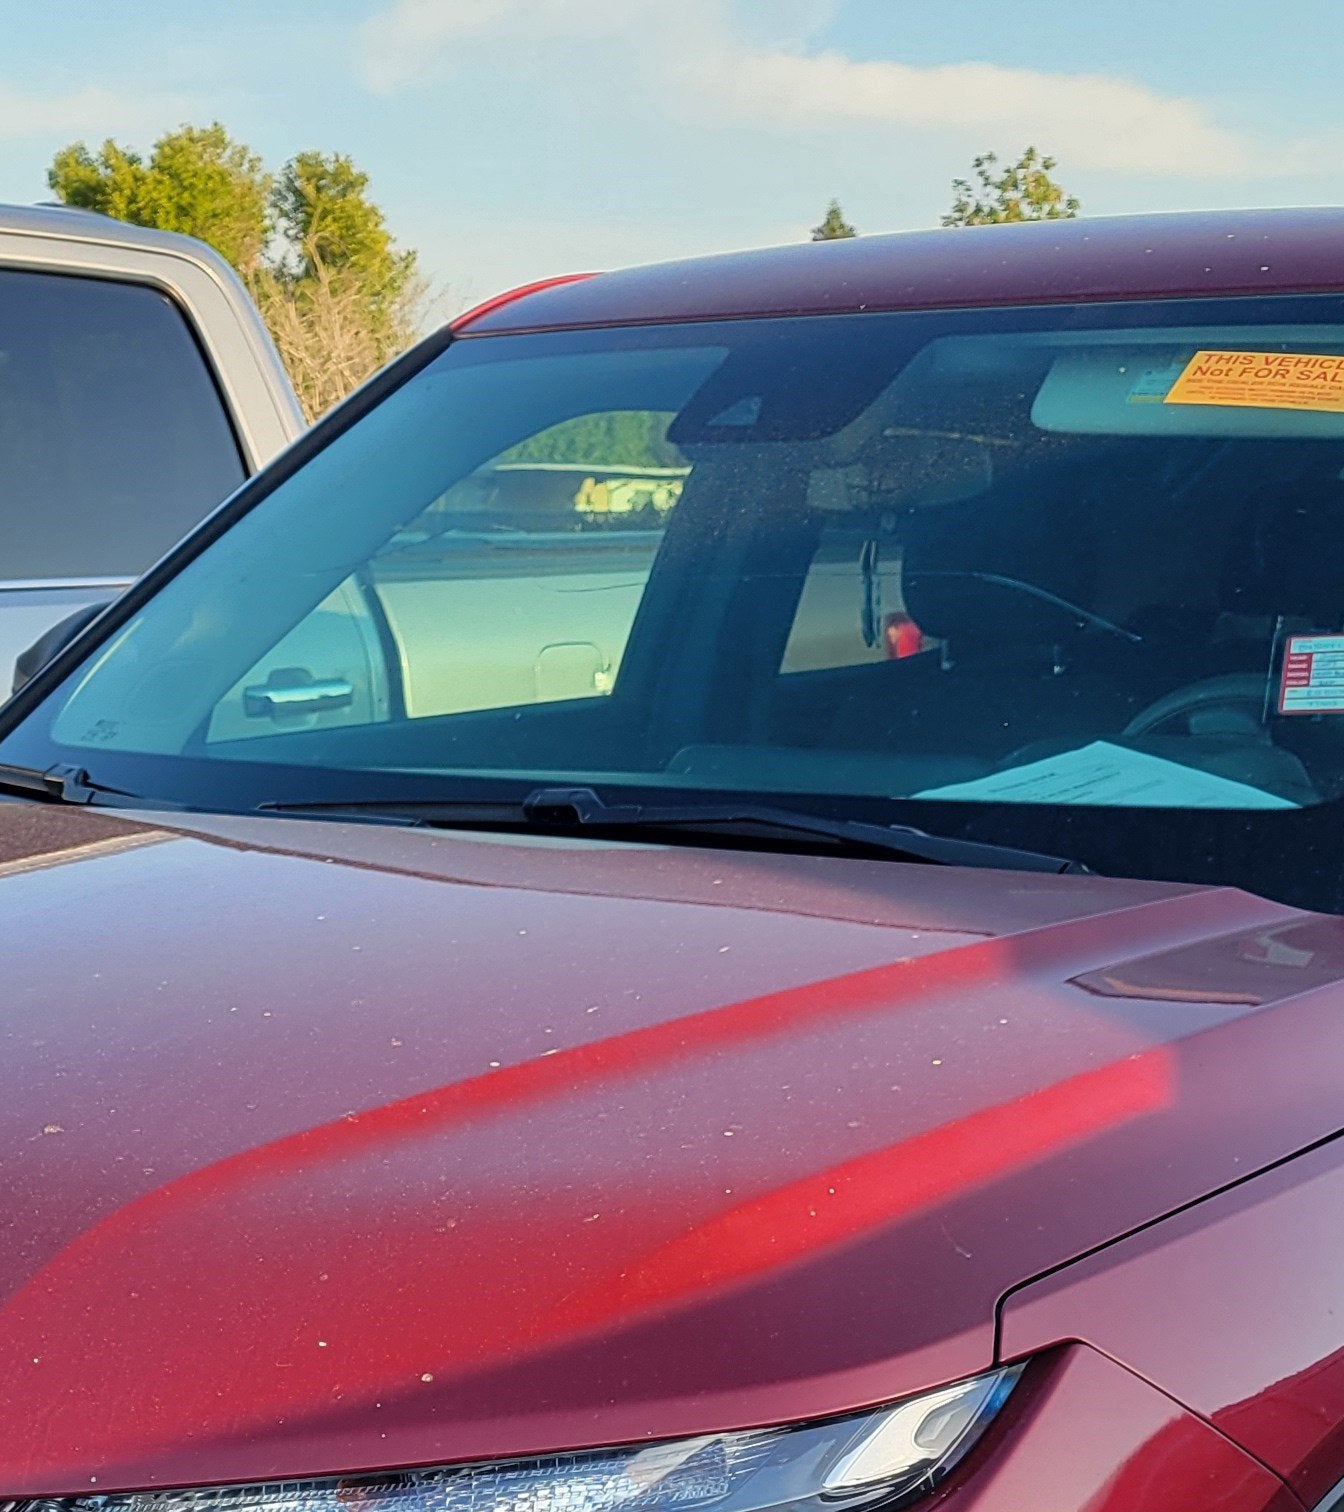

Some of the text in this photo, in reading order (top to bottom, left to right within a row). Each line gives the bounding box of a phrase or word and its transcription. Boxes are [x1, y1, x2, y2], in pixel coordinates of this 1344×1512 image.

[1204, 353, 1254, 365] THIS
[1193, 365, 1235, 378] Not
[1239, 367, 1291, 380] FOR
